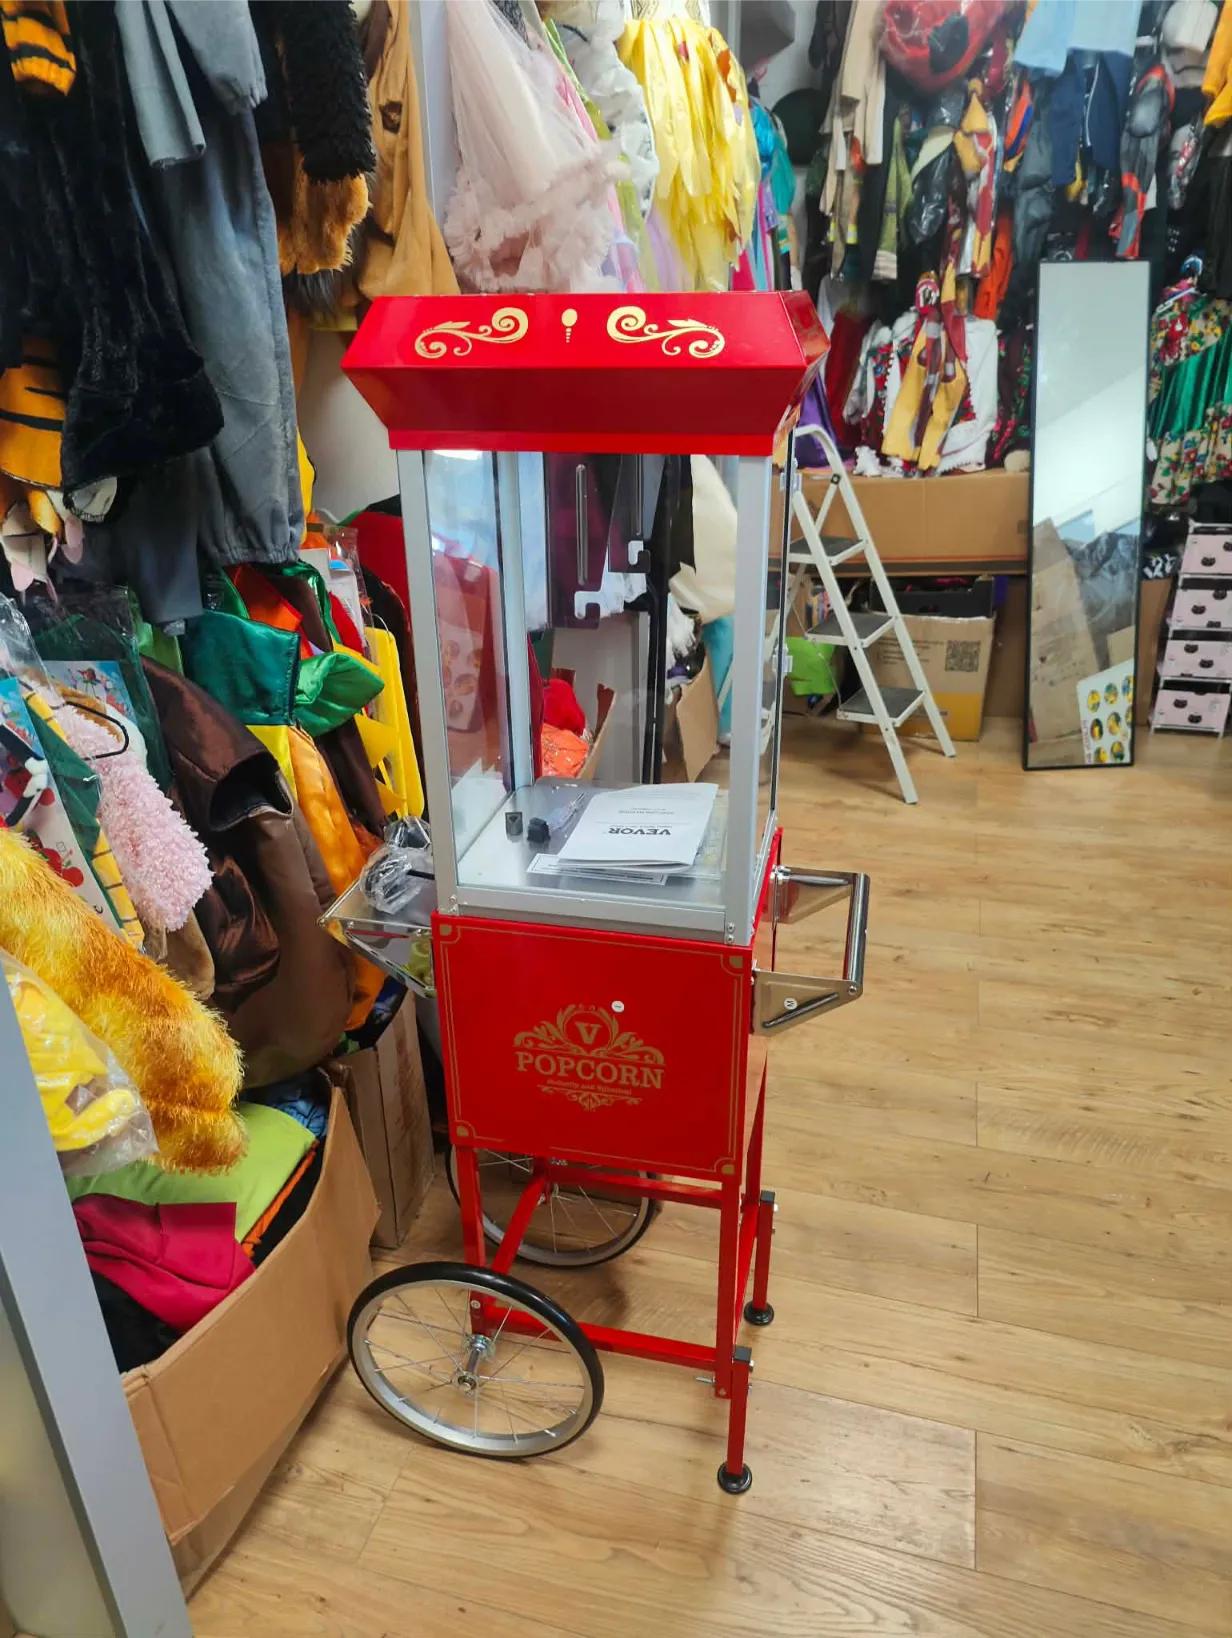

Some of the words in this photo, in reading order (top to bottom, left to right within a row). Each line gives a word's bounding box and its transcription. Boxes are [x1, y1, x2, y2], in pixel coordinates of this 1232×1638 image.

[608, 827, 671, 836] VEVOR
[574, 1021, 601, 1045] V
[514, 1051, 665, 1089] POPCORN
